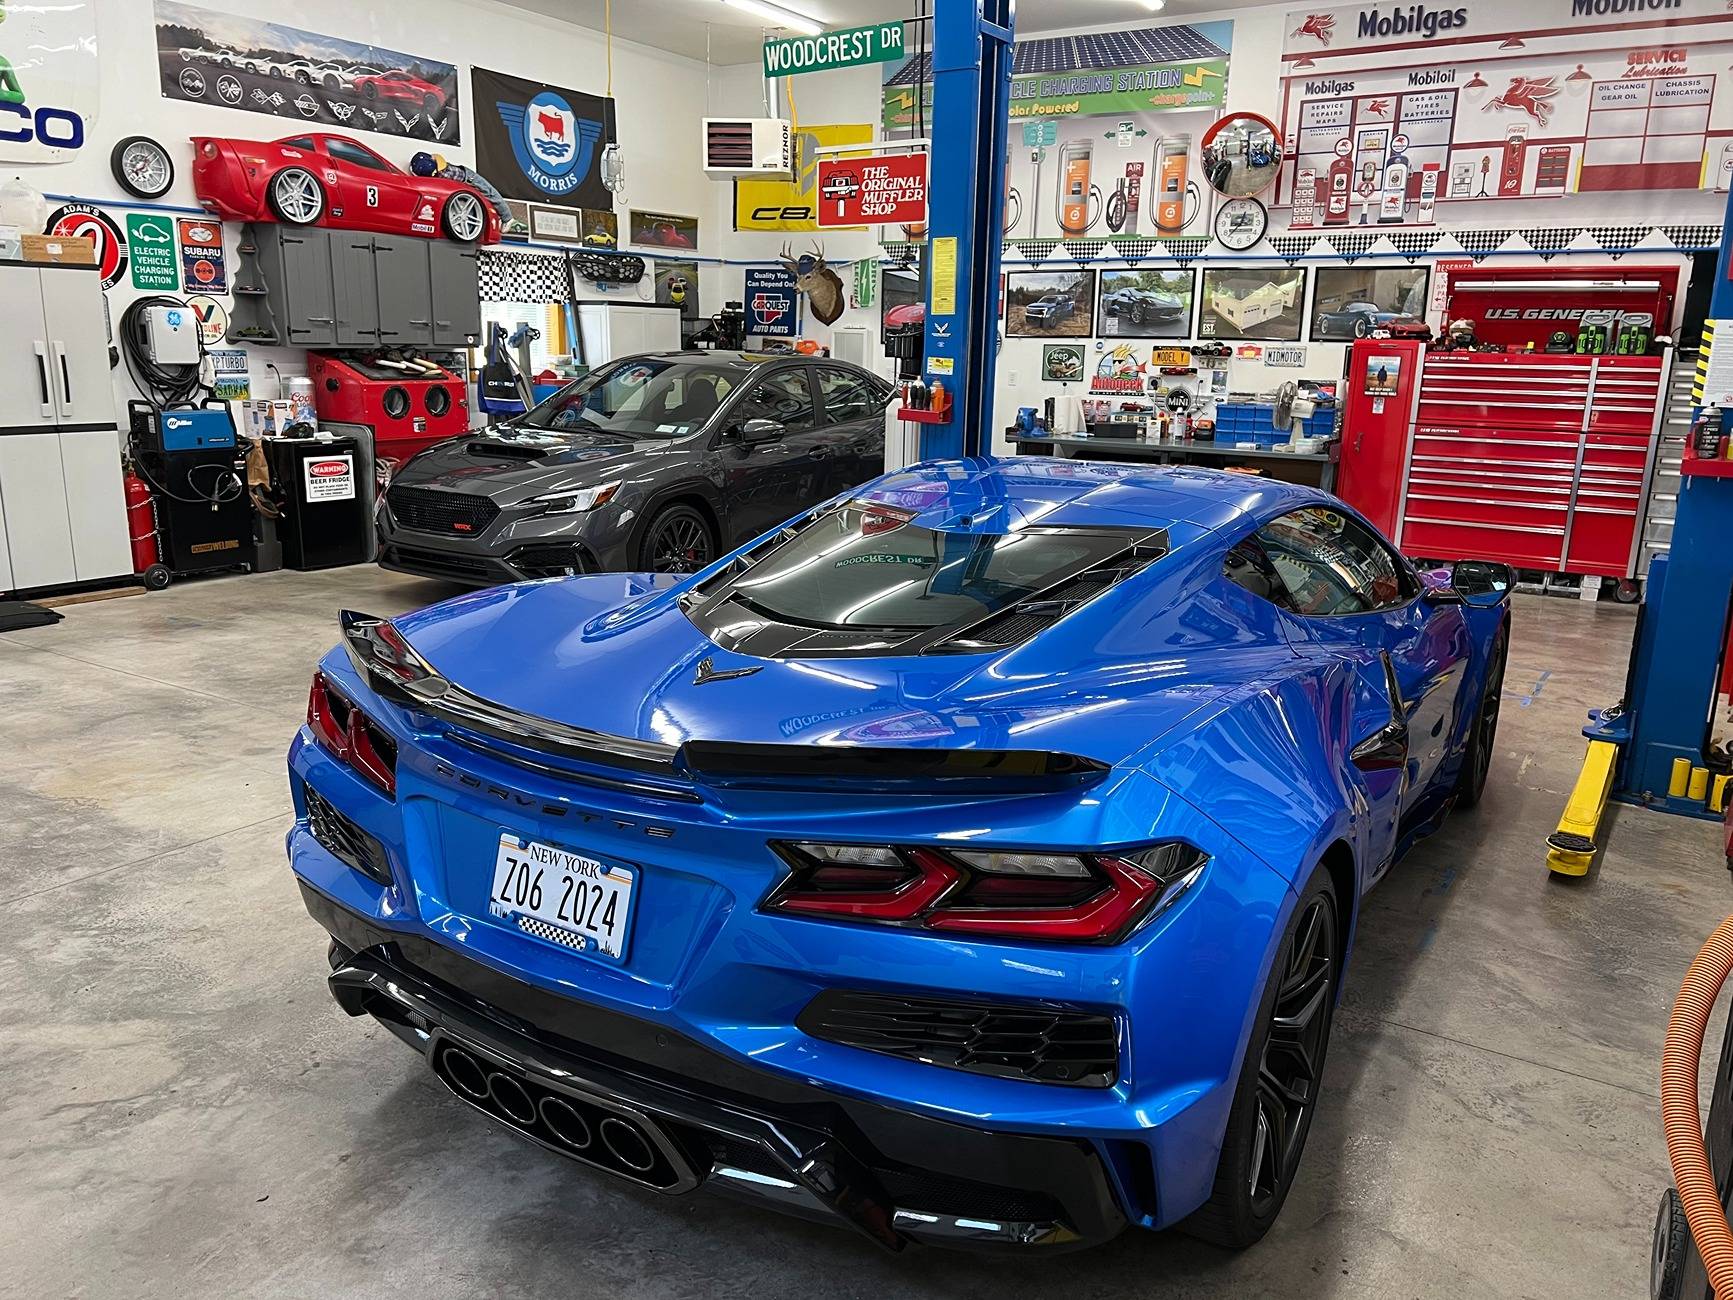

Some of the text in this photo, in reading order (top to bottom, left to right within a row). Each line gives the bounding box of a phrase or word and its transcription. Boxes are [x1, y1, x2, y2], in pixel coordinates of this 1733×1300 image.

[1357, 5, 1468, 38] Mobilgas
[765, 26, 902, 72] WOODCREST DR
[1626, 48, 1688, 66] SERVICE
[1621, 65, 1688, 78] Lubrication
[1039, 73, 1114, 98] CHARGING
[1117, 68, 1182, 92] STATION
[1407, 69, 1457, 87] Mobiloil
[1665, 79, 1701, 88] CHASSIS
[1304, 79, 1356, 97] Mobilgas
[1598, 82, 1647, 92] OIL CHANGE
[1655, 88, 1710, 97] LUBRICATION
[1601, 92, 1638, 101] GEAR OIL
[1008, 101, 1080, 117] olar Powered
[1311, 103, 1344, 111] SERVICE
[1310, 110, 1344, 118] REPAIRS
[1404, 110, 1450, 118] BATTERIES
[782, 124, 790, 168] REZNOR
[528, 164, 578, 191] MORRIS
[861, 166, 889, 180] THE
[861, 174, 924, 193] ORIGINAL
[368, 188, 377, 206] 3
[861, 186, 924, 204] MUFFLER
[63, 205, 100, 217] ADAM'S
[860, 202, 897, 216] SHOP
[134, 246, 171, 256] ELECTRIC
[184, 247, 221, 257] SUBARU
[137, 256, 170, 266] VEHICLE
[134, 265, 175, 275] CHARGING
[139, 275, 172, 284] STATION
[754, 272, 776, 280] Quality
[760, 280, 784, 288] Depend
[752, 300, 790, 311] CARQUEST
[1485, 308, 1519, 320] U.S.
[752, 325, 789, 333] AUTO PARTS
[1050, 352, 1068, 361] Jeep
[1156, 352, 1185, 362] MODEL Y
[1267, 352, 1302, 363] MIDMOTOR
[1091, 375, 1144, 392] Autogeek
[1168, 397, 1188, 407] MINI
[312, 465, 347, 473] WARNING
[436, 763, 677, 838] CORVETTE
[530, 844, 600, 880] NEW YORK
[500, 856, 619, 937] Z06 2024
